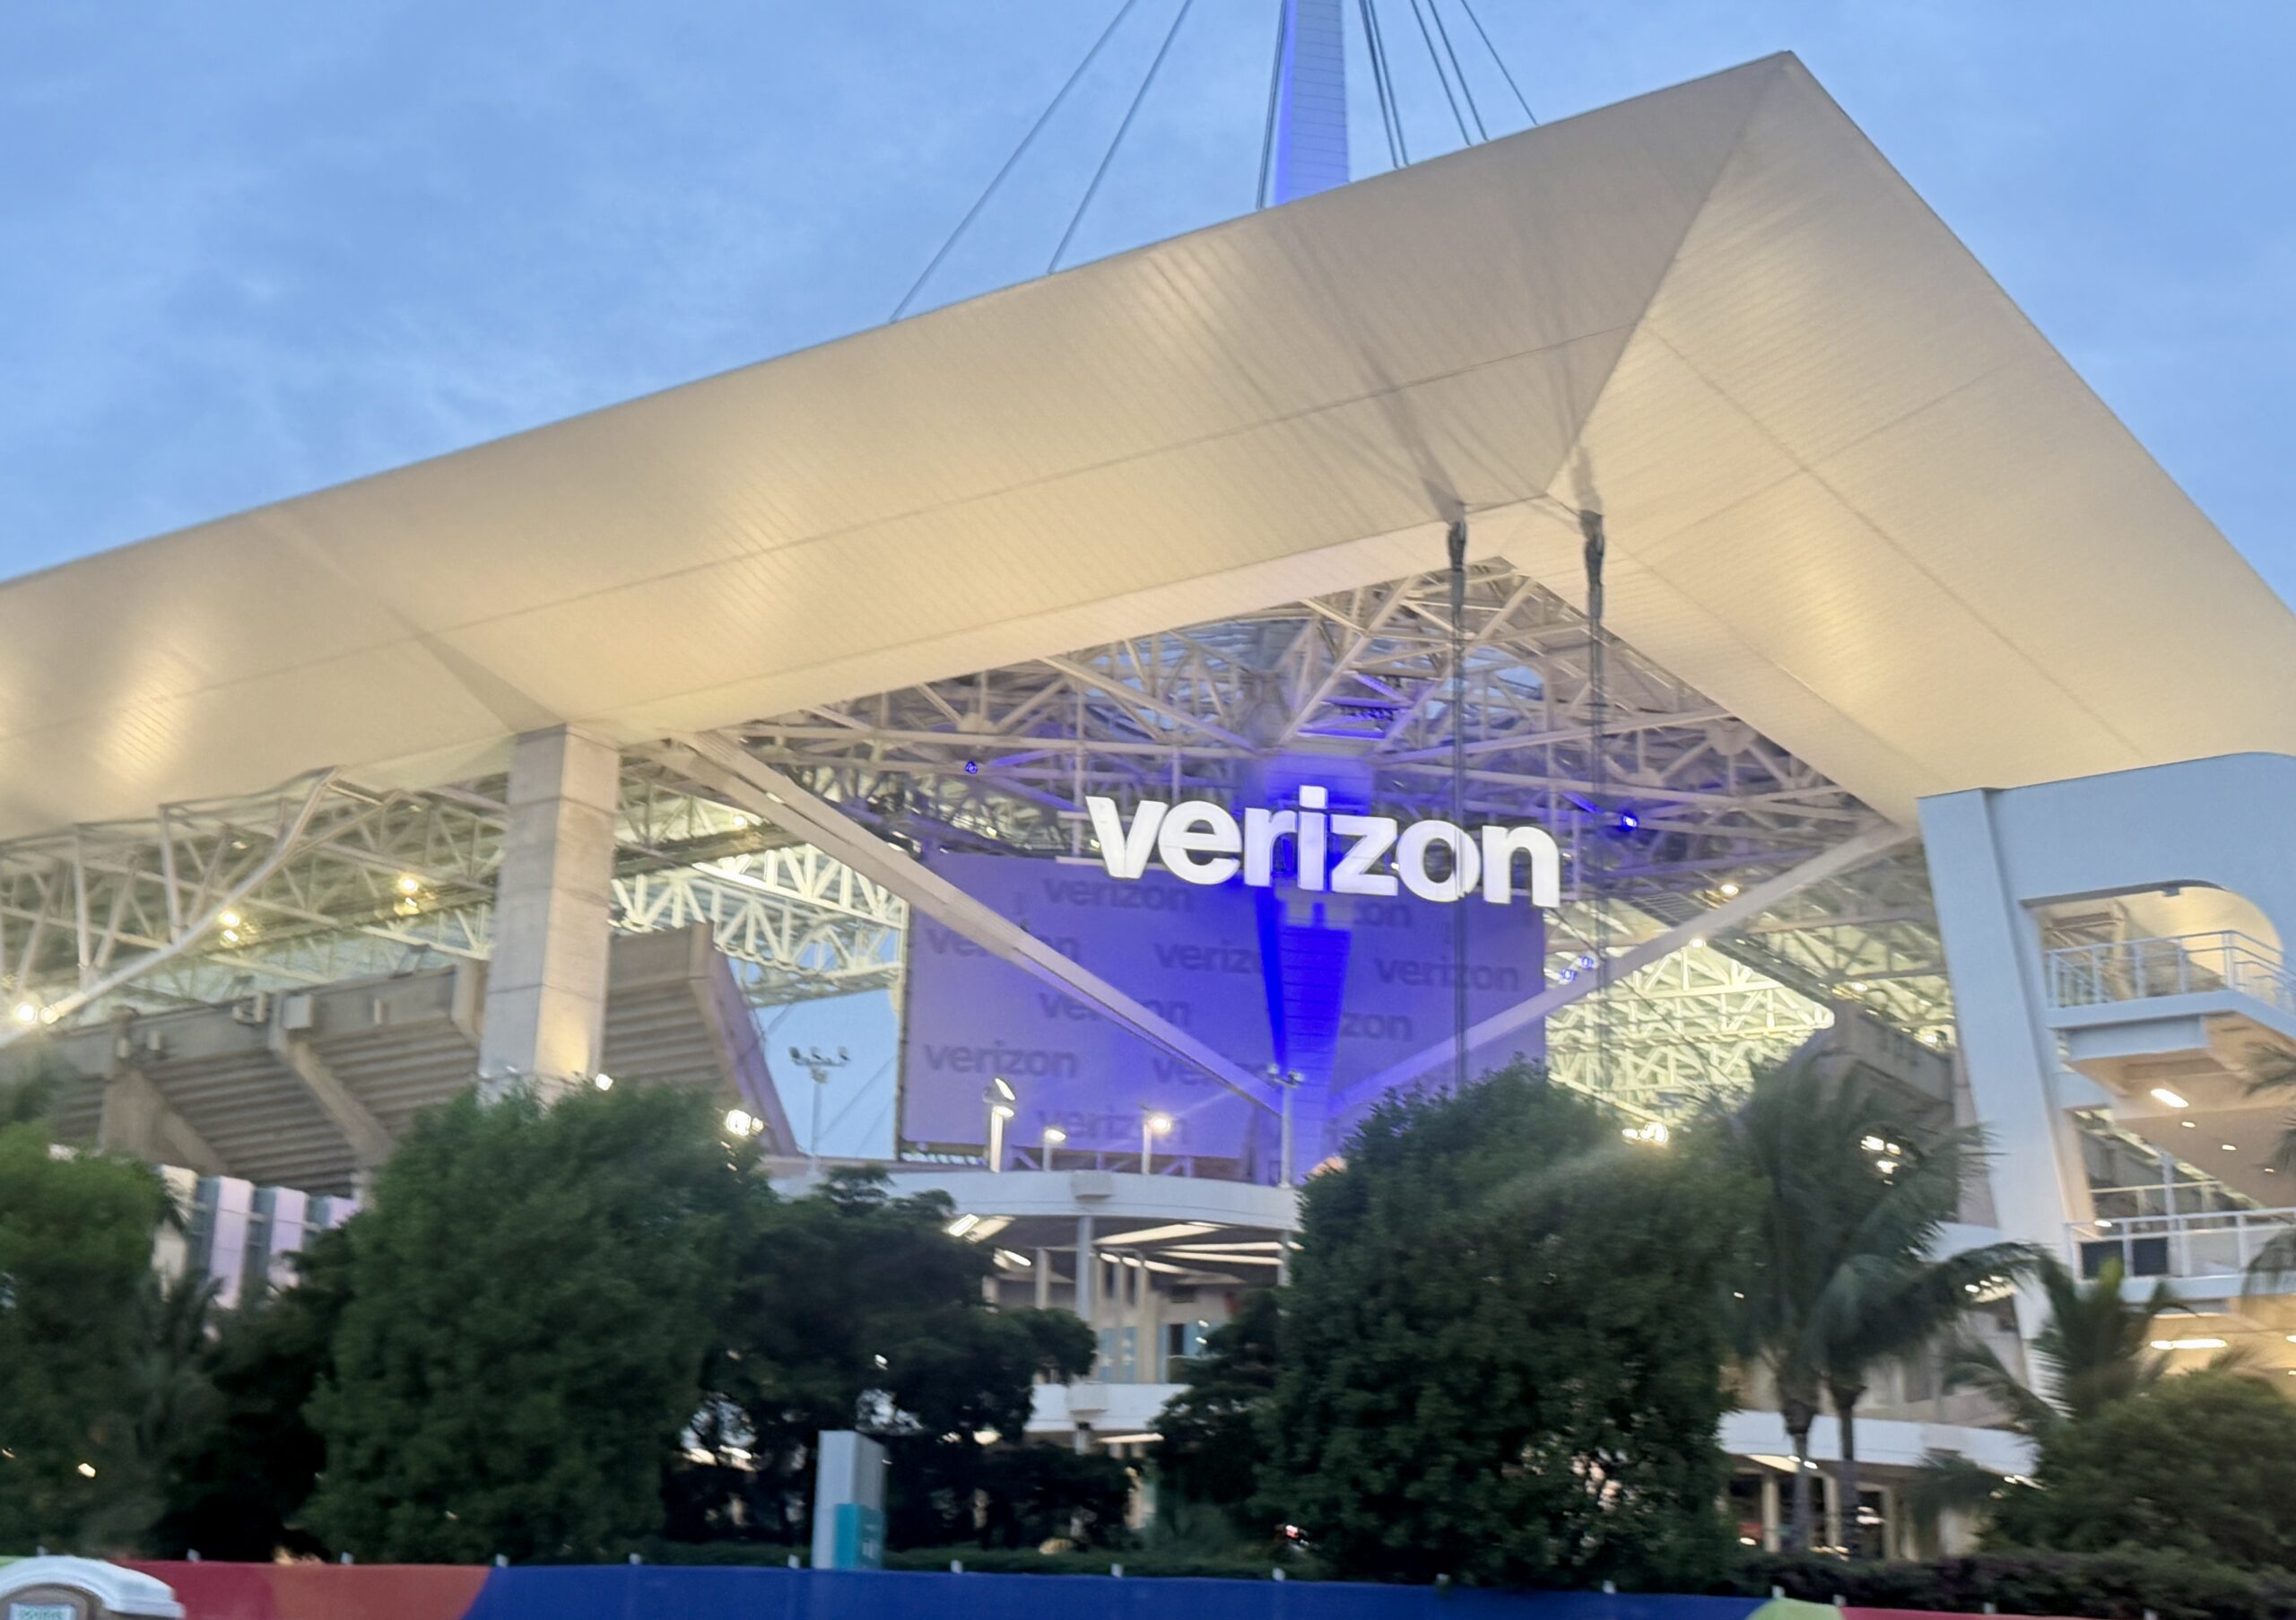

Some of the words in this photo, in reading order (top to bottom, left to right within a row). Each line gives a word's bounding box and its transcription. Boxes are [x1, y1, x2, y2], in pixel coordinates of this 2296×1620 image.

[1085, 785, 1561, 908] verizon
[1042, 876, 1193, 912] verizon
[1153, 938, 1262, 975] veriz
[923, 1039, 1077, 1078] verizon
